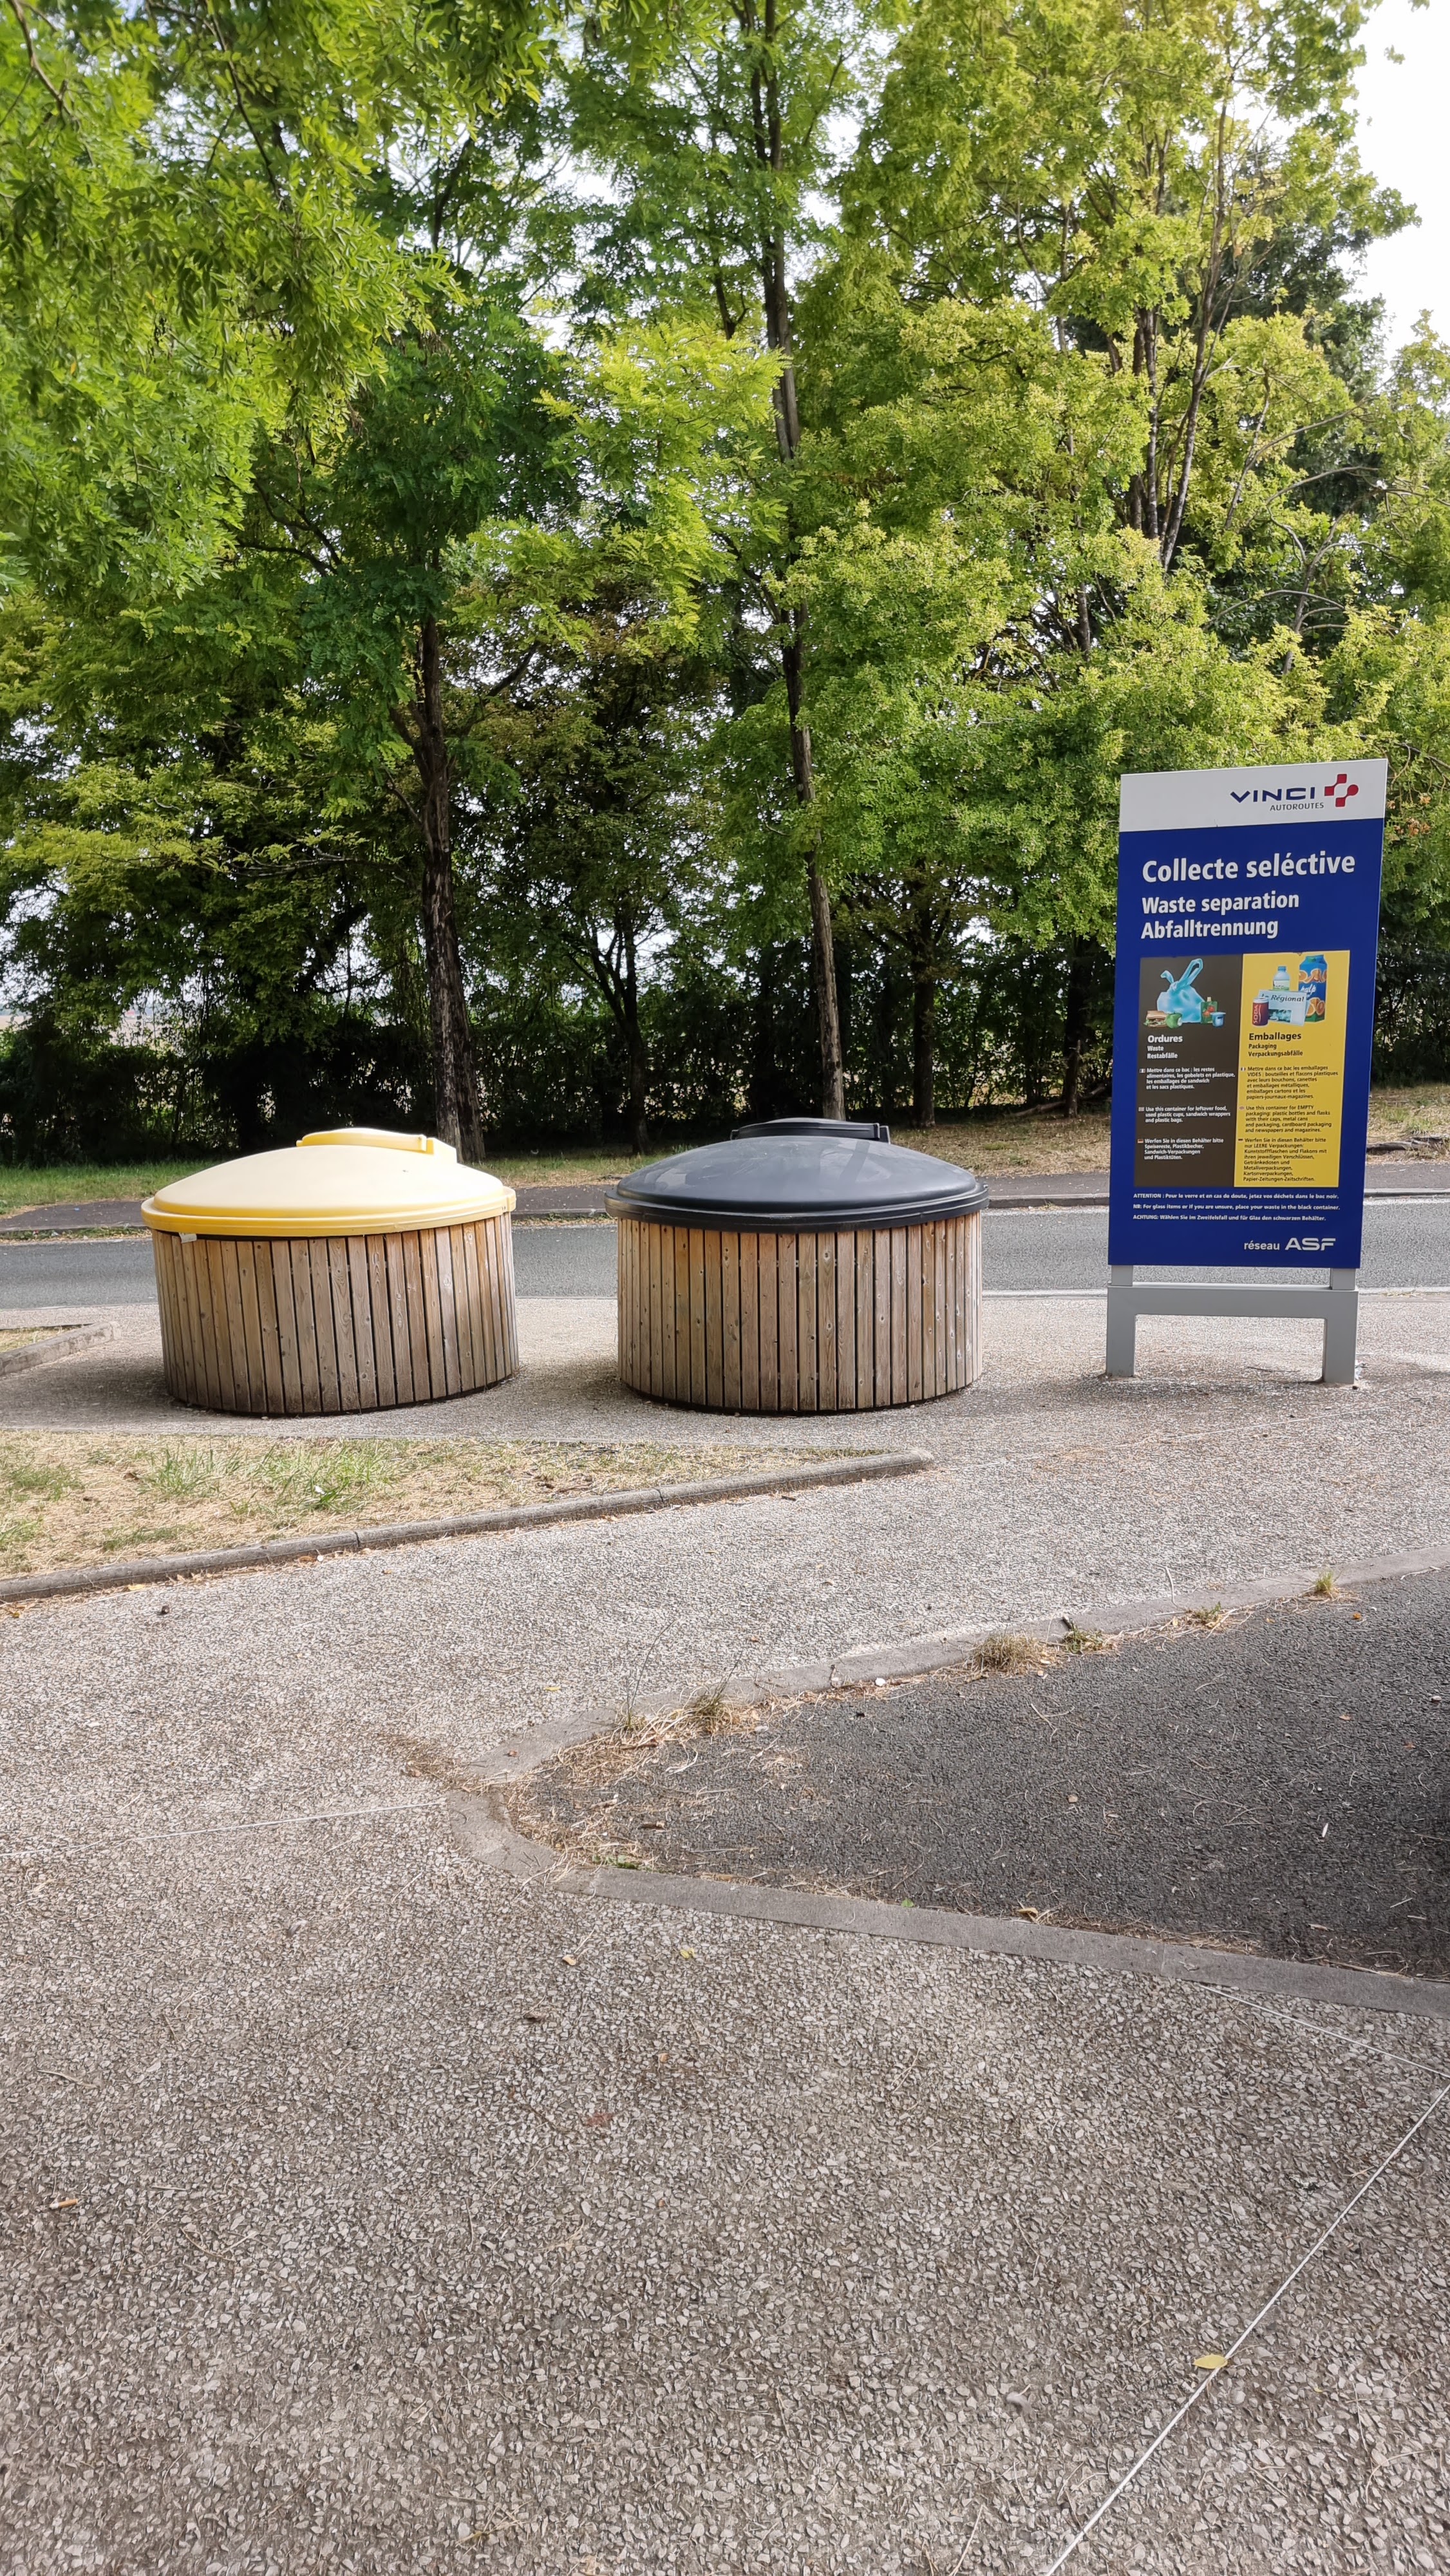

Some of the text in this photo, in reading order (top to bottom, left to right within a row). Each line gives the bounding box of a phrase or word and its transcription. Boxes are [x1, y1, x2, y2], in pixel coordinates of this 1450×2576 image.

[1230, 786, 1315, 803] VINCI
[1270, 802, 1324, 811] AUTOROUTES
[1142, 850, 1355, 883] Collecte seléctive
[1142, 890, 1299, 915] Waste separation
[1141, 920, 1278, 940] Abfalltrennung
[1271, 994, 1304, 1003] Régional
[1147, 1034, 1183, 1043] Ordures
[1249, 1032, 1301, 1041] Emballages
[1244, 1238, 1335, 1251] réseau ASF
